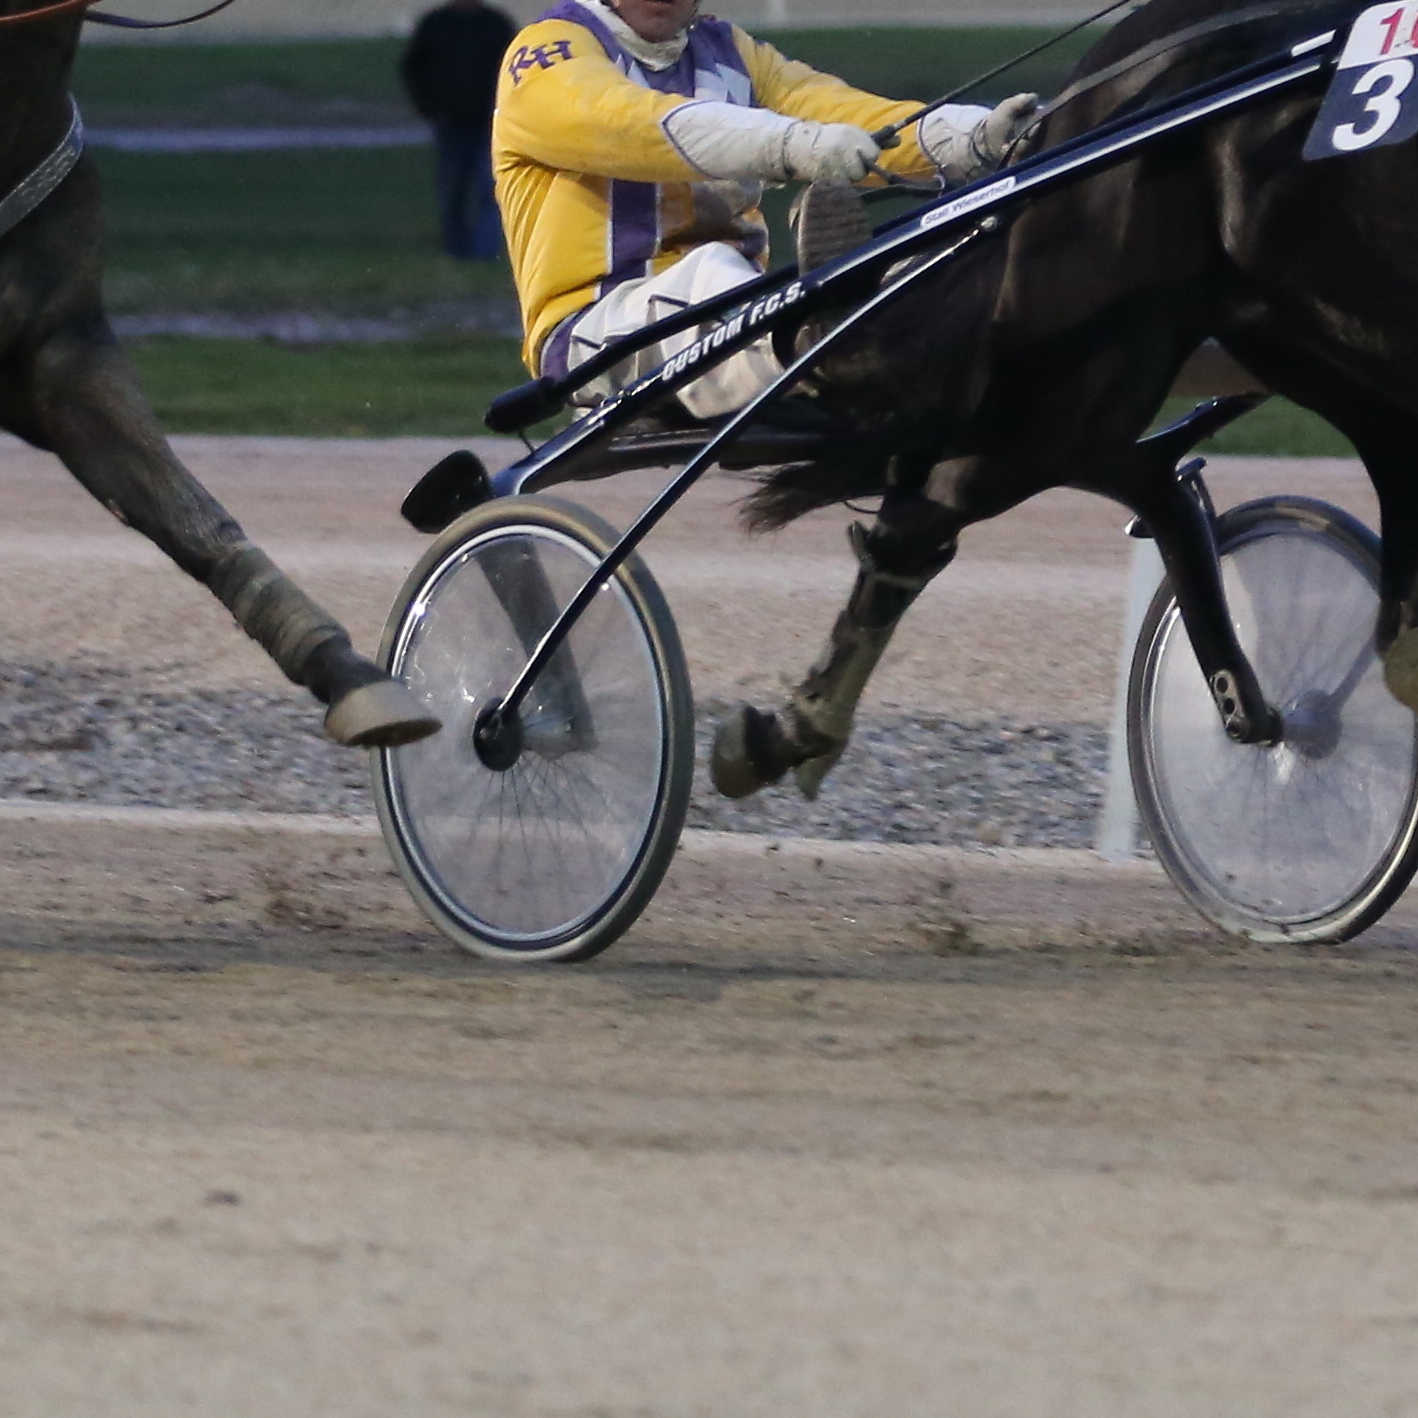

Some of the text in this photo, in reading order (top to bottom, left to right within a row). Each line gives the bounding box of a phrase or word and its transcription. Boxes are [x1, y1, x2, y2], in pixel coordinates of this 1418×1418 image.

[1332, 58, 1415, 152] 3
[662, 281, 806, 381] CUSTOM F.C.S.
